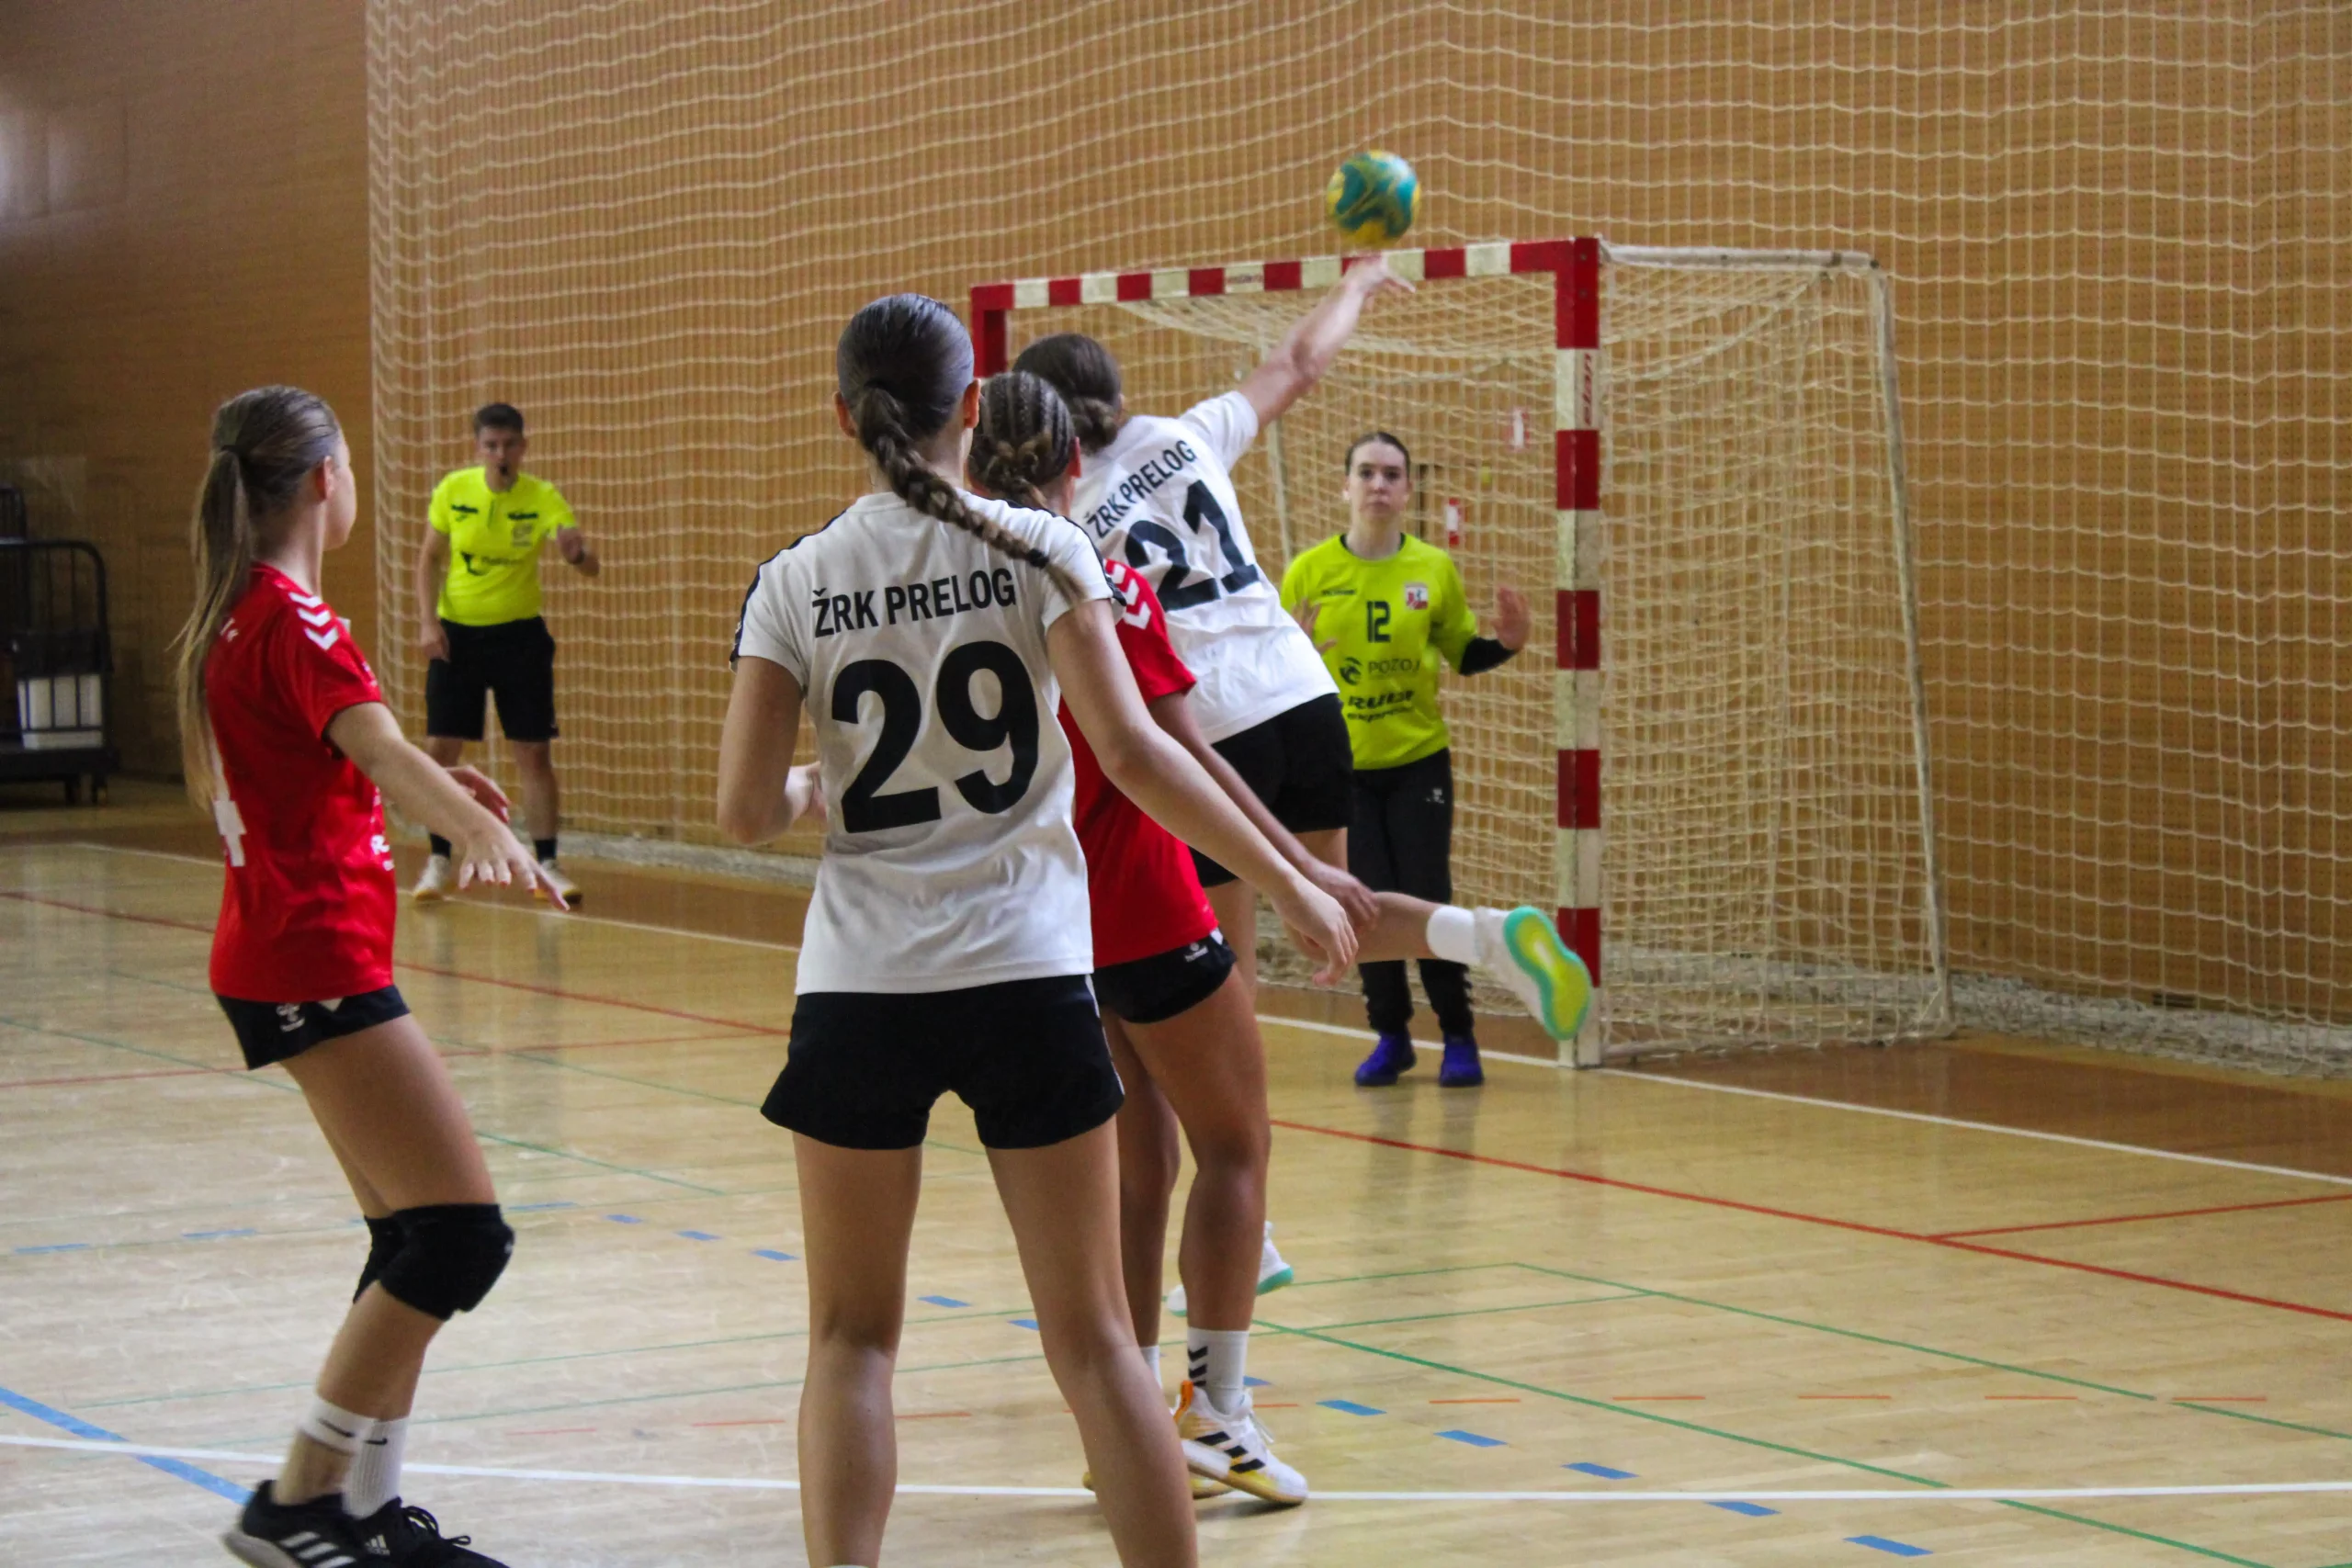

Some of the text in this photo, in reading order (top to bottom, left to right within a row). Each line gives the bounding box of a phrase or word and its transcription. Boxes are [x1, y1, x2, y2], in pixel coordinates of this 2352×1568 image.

[1084, 440, 1198, 539] ŽRK PRELOG
[1125, 479, 1261, 613] 21
[811, 568, 1017, 638] ŽRK PRELOG
[1366, 600, 1392, 644] 12
[831, 640, 1040, 834] 29
